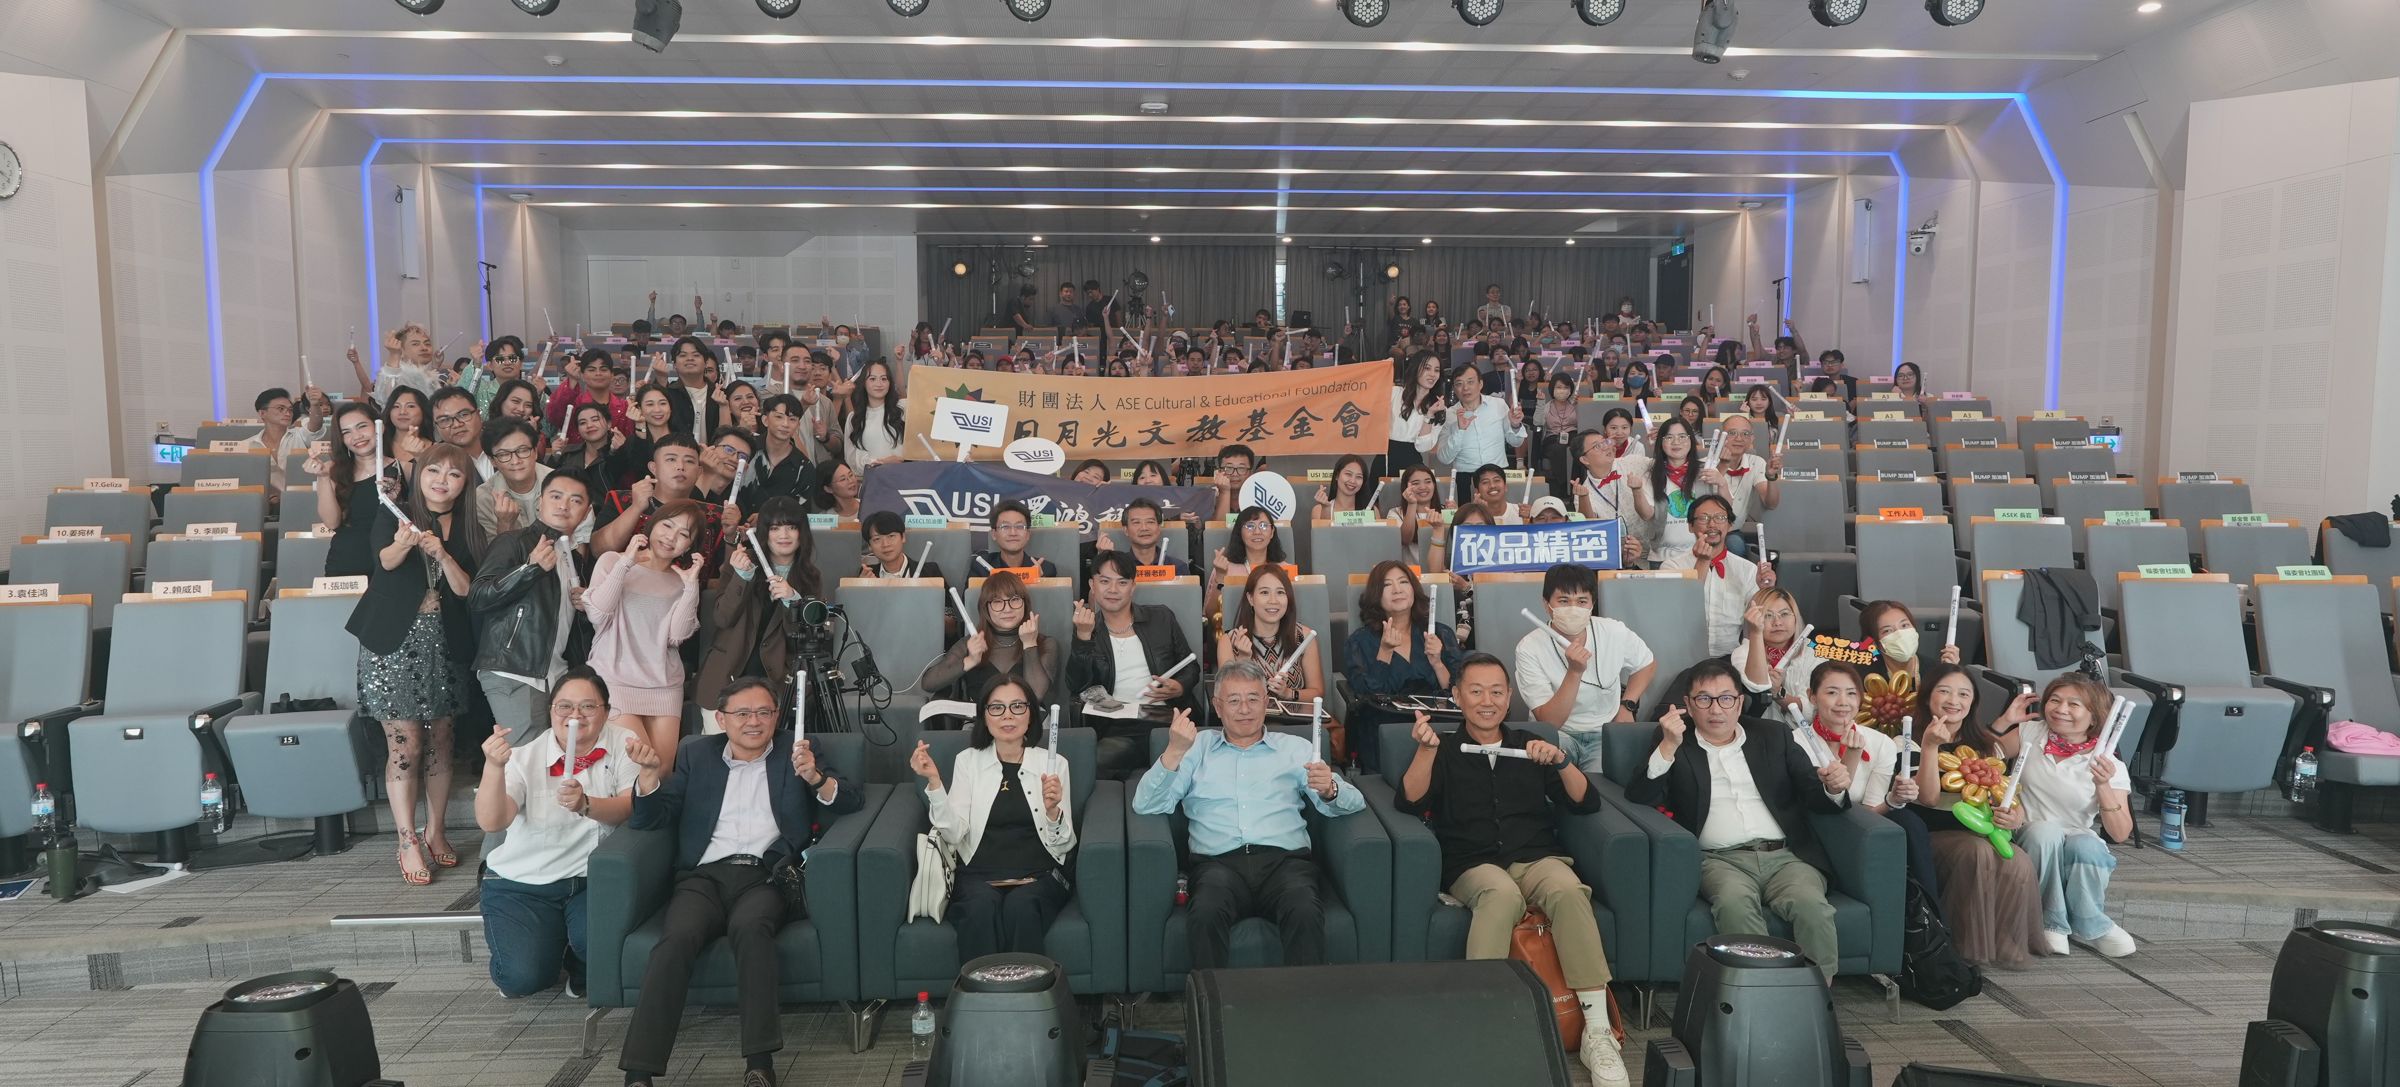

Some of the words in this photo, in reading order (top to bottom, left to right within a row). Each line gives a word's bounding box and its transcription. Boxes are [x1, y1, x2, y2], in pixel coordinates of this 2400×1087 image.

[1018, 388, 1107, 412] 財團法人
[1116, 396, 1140, 410] ASE
[1144, 394, 1196, 410] Cultural
[1200, 395, 1210, 408] &
[1215, 388, 1291, 408] Educational
[1294, 379, 1368, 396] Foundation
[972, 414, 992, 427] USI
[1013, 400, 1371, 448] 日月光文教基金會
[1032, 450, 1054, 458] USI
[952, 491, 1000, 516] USI
[1268, 498, 1285, 513] USI
[1886, 510, 1916, 518] 工作人員
[1815, 644, 1873, 665] 領錢找我
